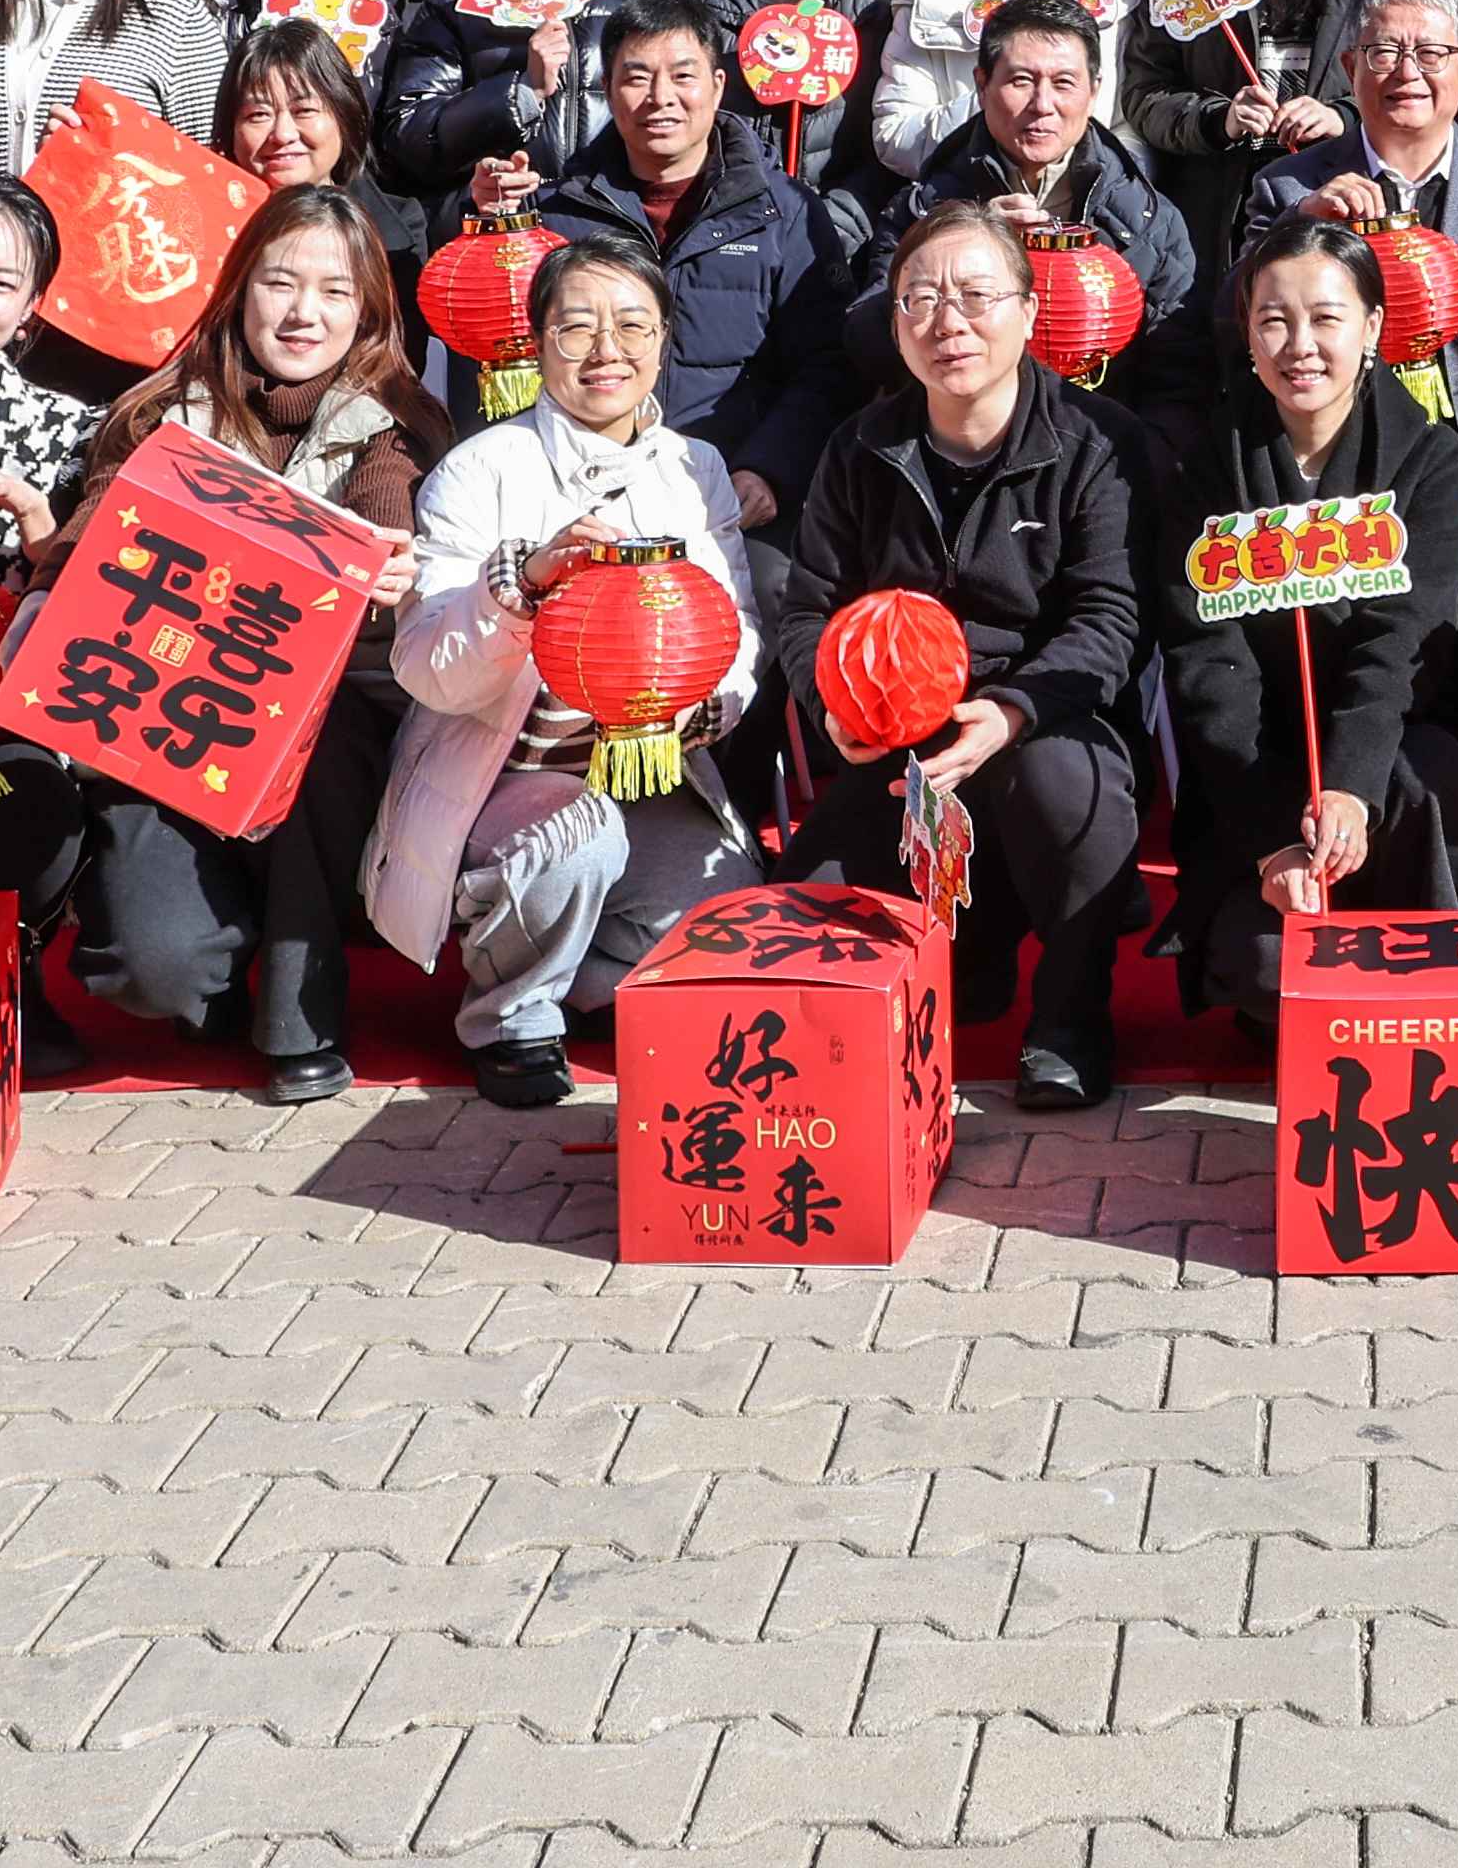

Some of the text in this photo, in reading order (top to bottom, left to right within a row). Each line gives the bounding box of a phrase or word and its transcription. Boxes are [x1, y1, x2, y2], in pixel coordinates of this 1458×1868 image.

[1199, 521, 1393, 585] 大吉大利
[1201, 568, 1406, 619] HAPPY NEW YEAR
[755, 1117, 837, 1150] HAO
[680, 1203, 750, 1232] YUN
